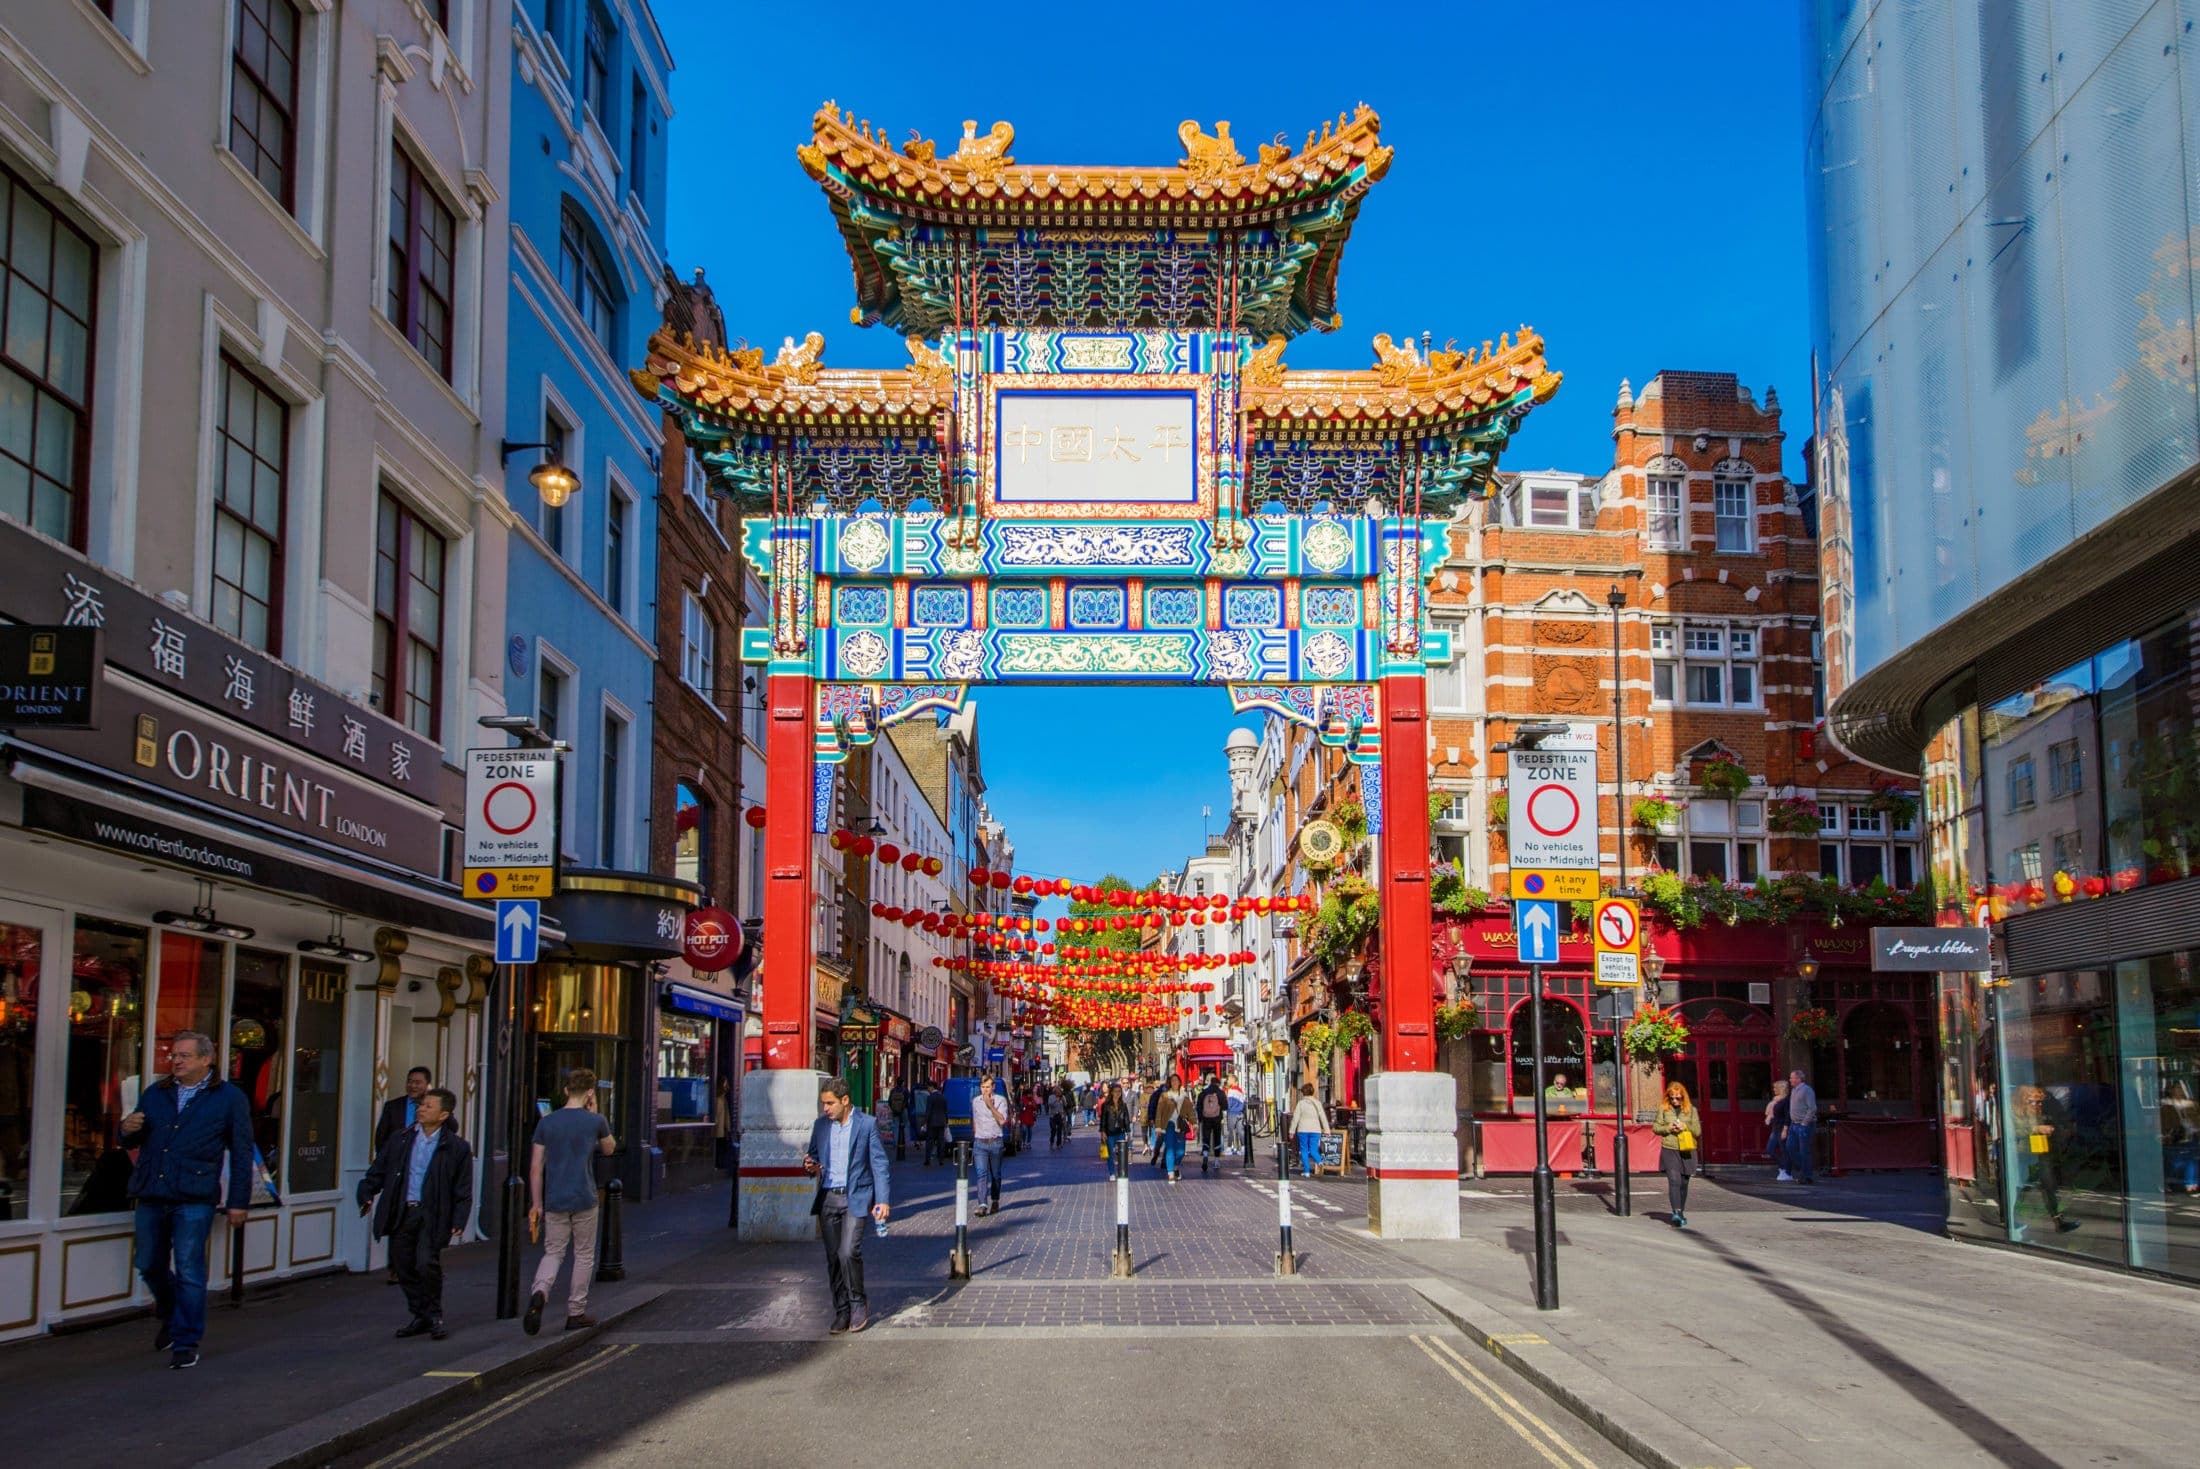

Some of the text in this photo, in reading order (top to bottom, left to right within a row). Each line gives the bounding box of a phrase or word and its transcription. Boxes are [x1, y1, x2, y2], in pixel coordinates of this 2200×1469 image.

[1004, 423, 1189, 464] 中國太平
[15, 704, 62, 714] LONDON
[476, 753, 546, 762] PEDESTRIAN
[1517, 755, 1588, 763] PEDESTRIAN
[486, 765, 535, 779] ZONE
[1527, 767, 1577, 780] ZONE
[167, 729, 336, 829] ORIENT
[336, 816, 387, 848] LONDON
[95, 821, 252, 876] www.orientlondon.com
[479, 840, 539, 849] No vehicles
[1524, 842, 1584, 851] No vehicles
[468, 854, 496, 863] Noon
[504, 853, 549, 864] Midnight
[1514, 856, 1541, 864] Noon
[1550, 855, 1594, 866] Midnight
[506, 872, 541, 883] At any
[1554, 875, 1587, 885] At any
[511, 884, 535, 893] time
[1559, 885, 1582, 894] time
[686, 934, 730, 945] HOT POT
[1600, 954, 1623, 963] Except
